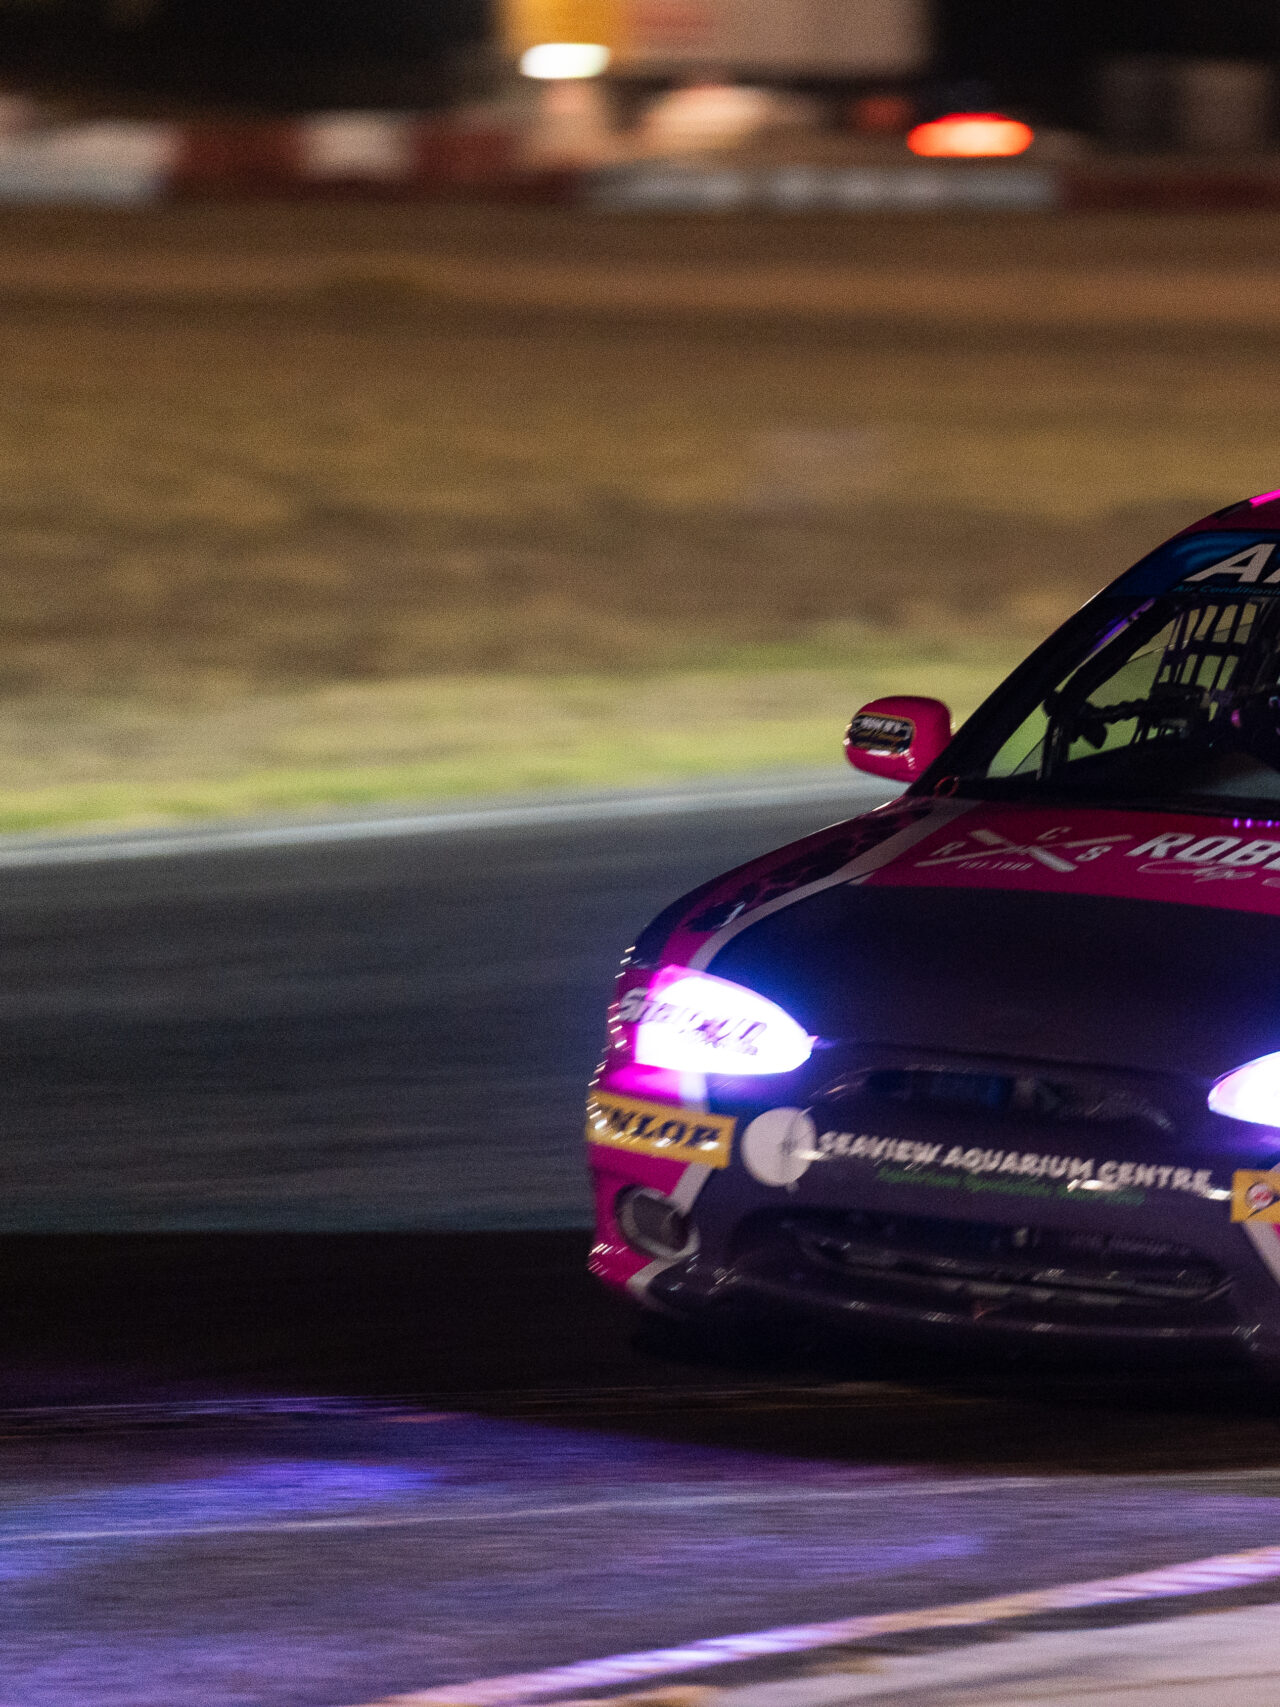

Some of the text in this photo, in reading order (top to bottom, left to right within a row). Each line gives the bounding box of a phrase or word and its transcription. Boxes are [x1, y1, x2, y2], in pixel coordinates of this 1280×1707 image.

[817, 1129, 944, 1164] SEAVIEW
[940, 1144, 1096, 1181] AQUARIUM
[1096, 1159, 1214, 1195] CENTRE
